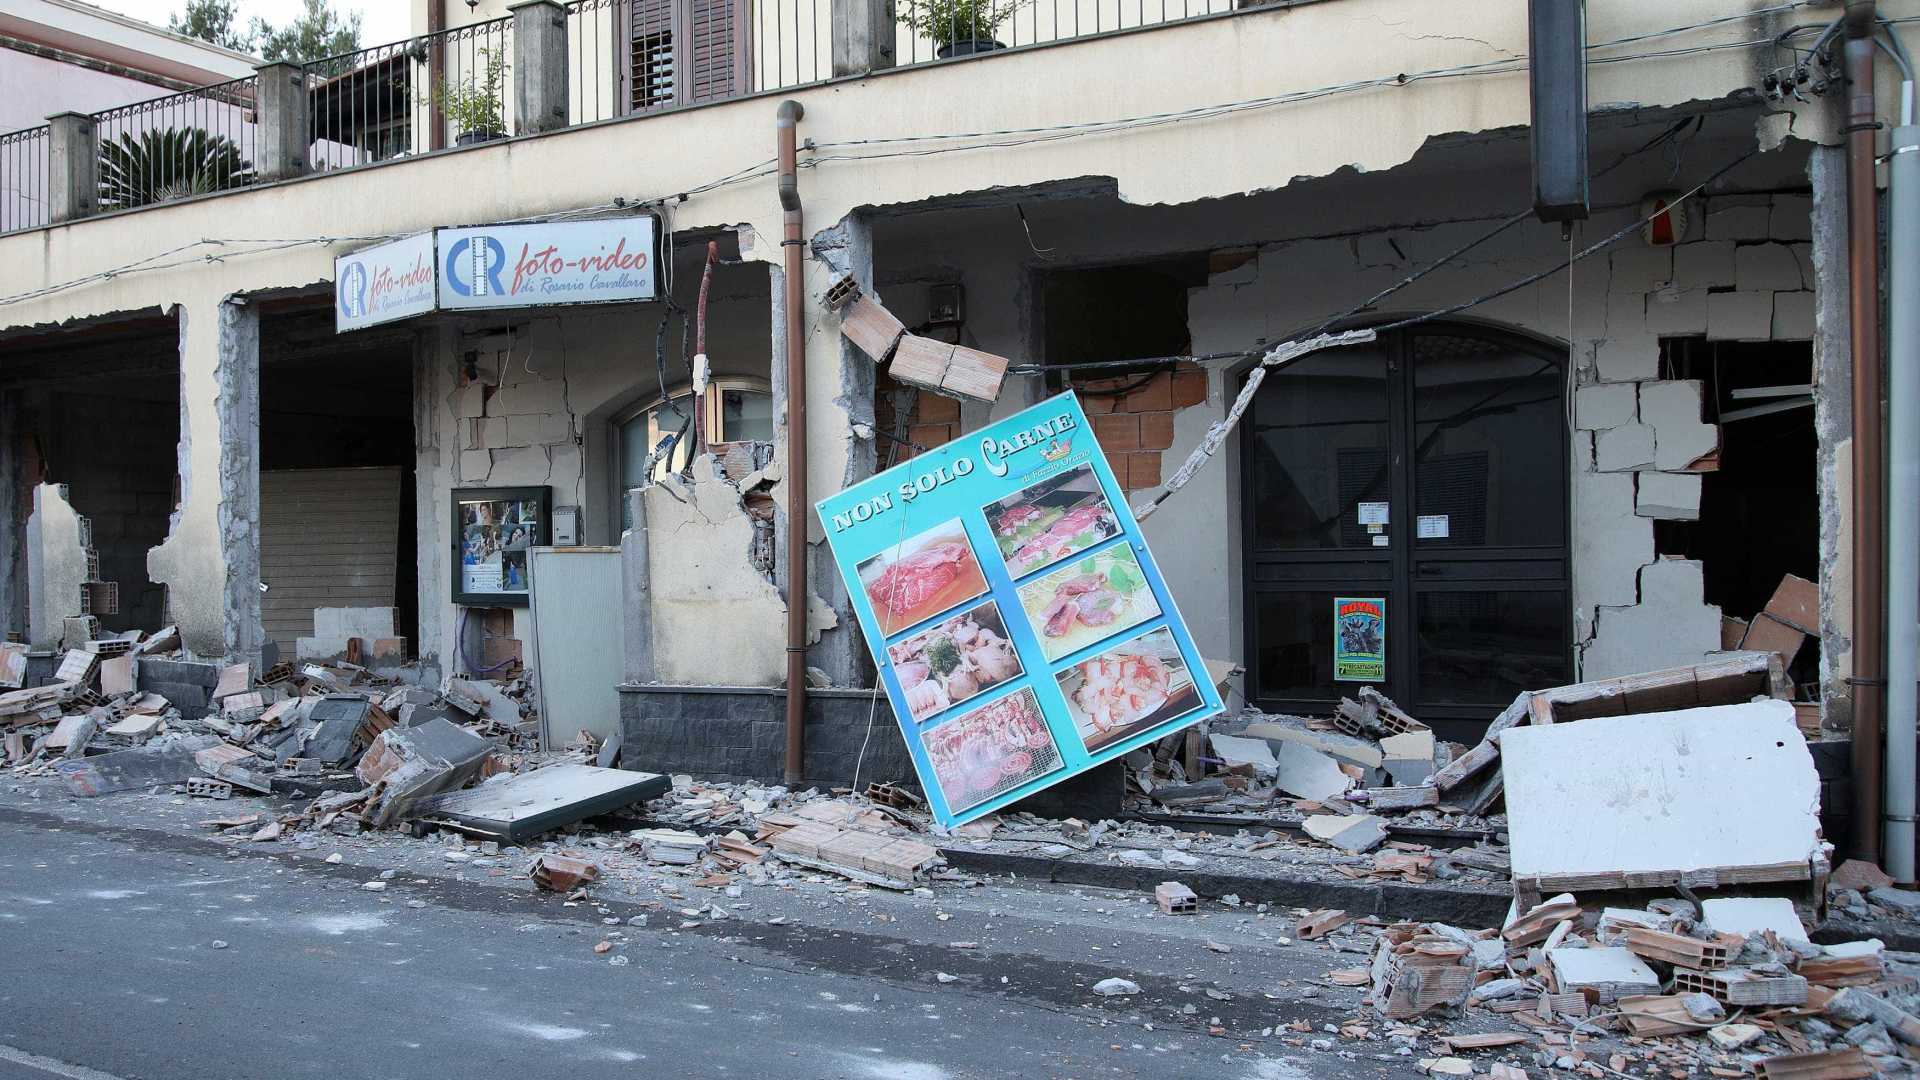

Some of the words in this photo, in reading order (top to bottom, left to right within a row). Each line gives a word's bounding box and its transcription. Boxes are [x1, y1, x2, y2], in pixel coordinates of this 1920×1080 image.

[368, 251, 432, 314] foto-video
[511, 237, 648, 296] foto-video
[520, 279, 535, 293] di
[541, 276, 585, 295] Rosario
[589, 273, 647, 290] Cavallaro
[832, 491, 893, 534] NON
[898, 457, 975, 504] SOLO
[980, 411, 1077, 477] CARNE
